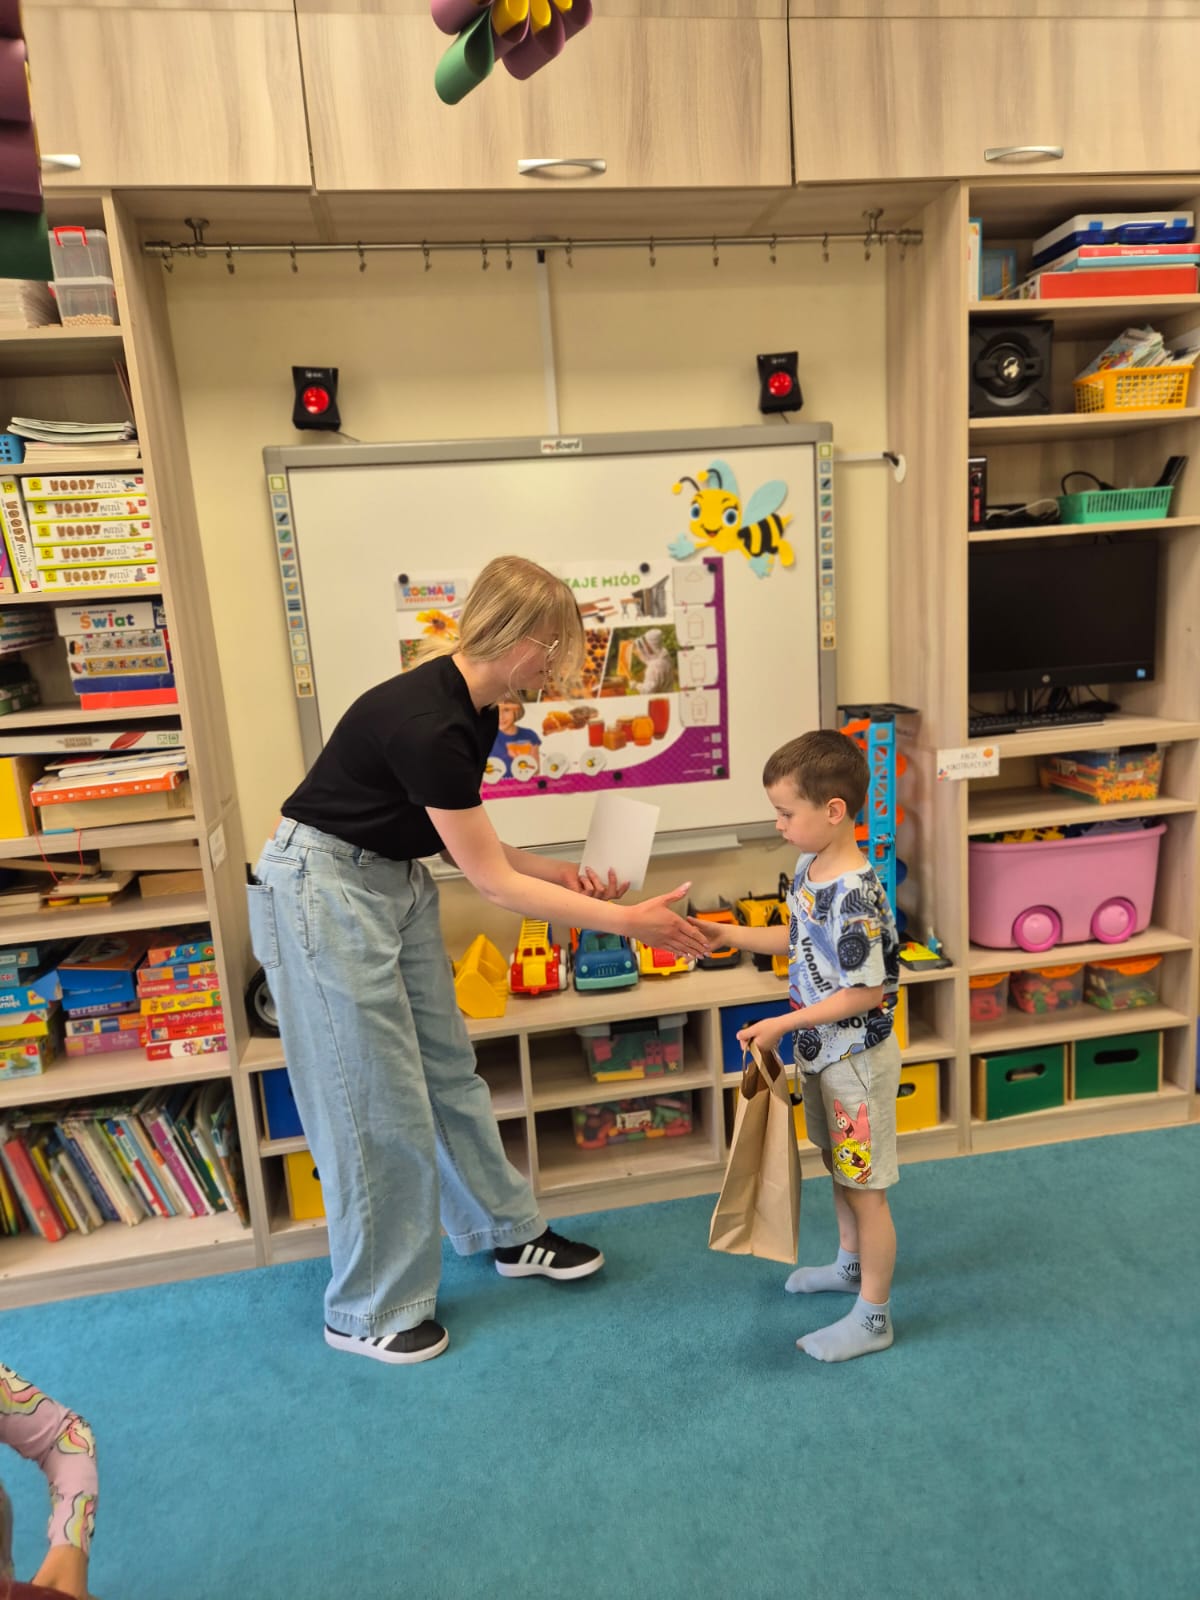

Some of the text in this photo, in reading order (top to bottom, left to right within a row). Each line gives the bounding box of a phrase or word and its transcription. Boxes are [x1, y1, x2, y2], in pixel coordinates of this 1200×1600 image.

[602, 571, 640, 586] MIÓD
[80, 611, 135, 630] Świat
[800, 936, 834, 993] Vroom!!
